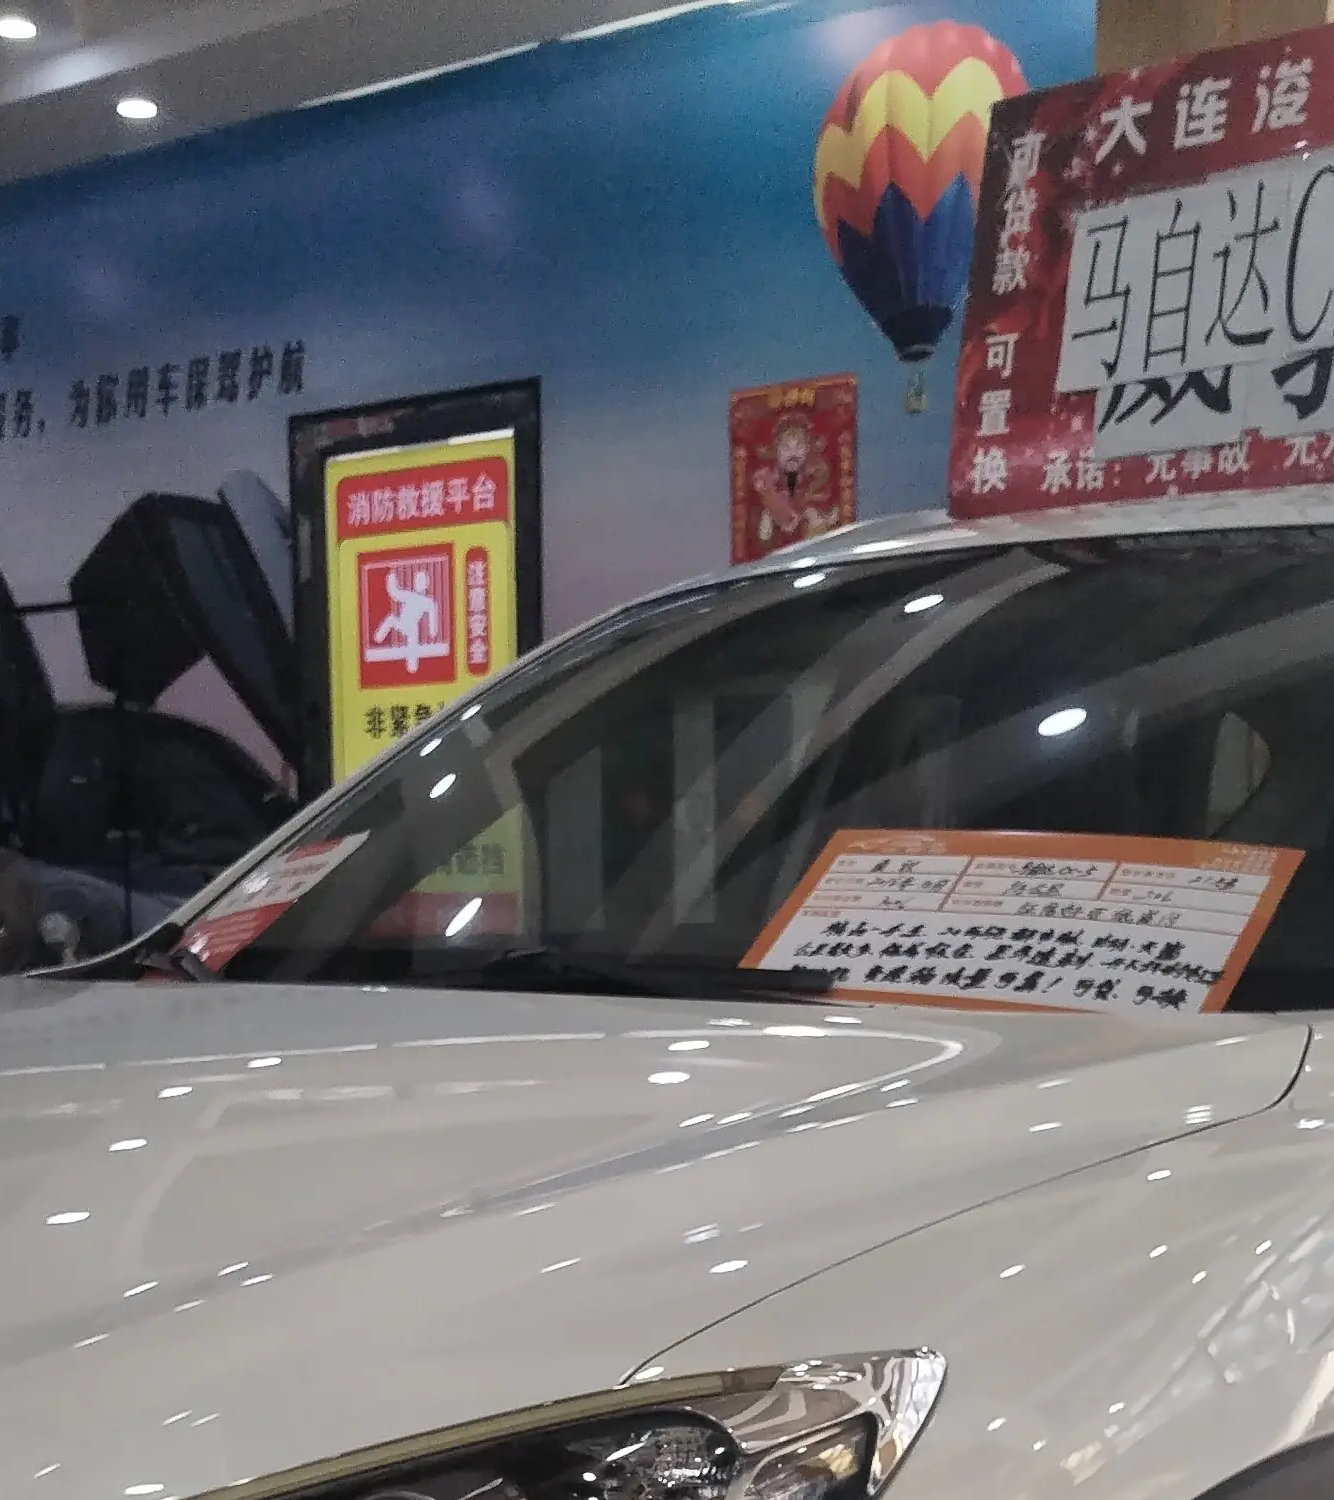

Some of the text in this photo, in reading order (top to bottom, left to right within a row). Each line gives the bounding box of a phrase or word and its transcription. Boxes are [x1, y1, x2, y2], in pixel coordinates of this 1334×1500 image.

[970, 331, 1020, 496] 可置换
[347, 472, 498, 527] 消防救援平台
